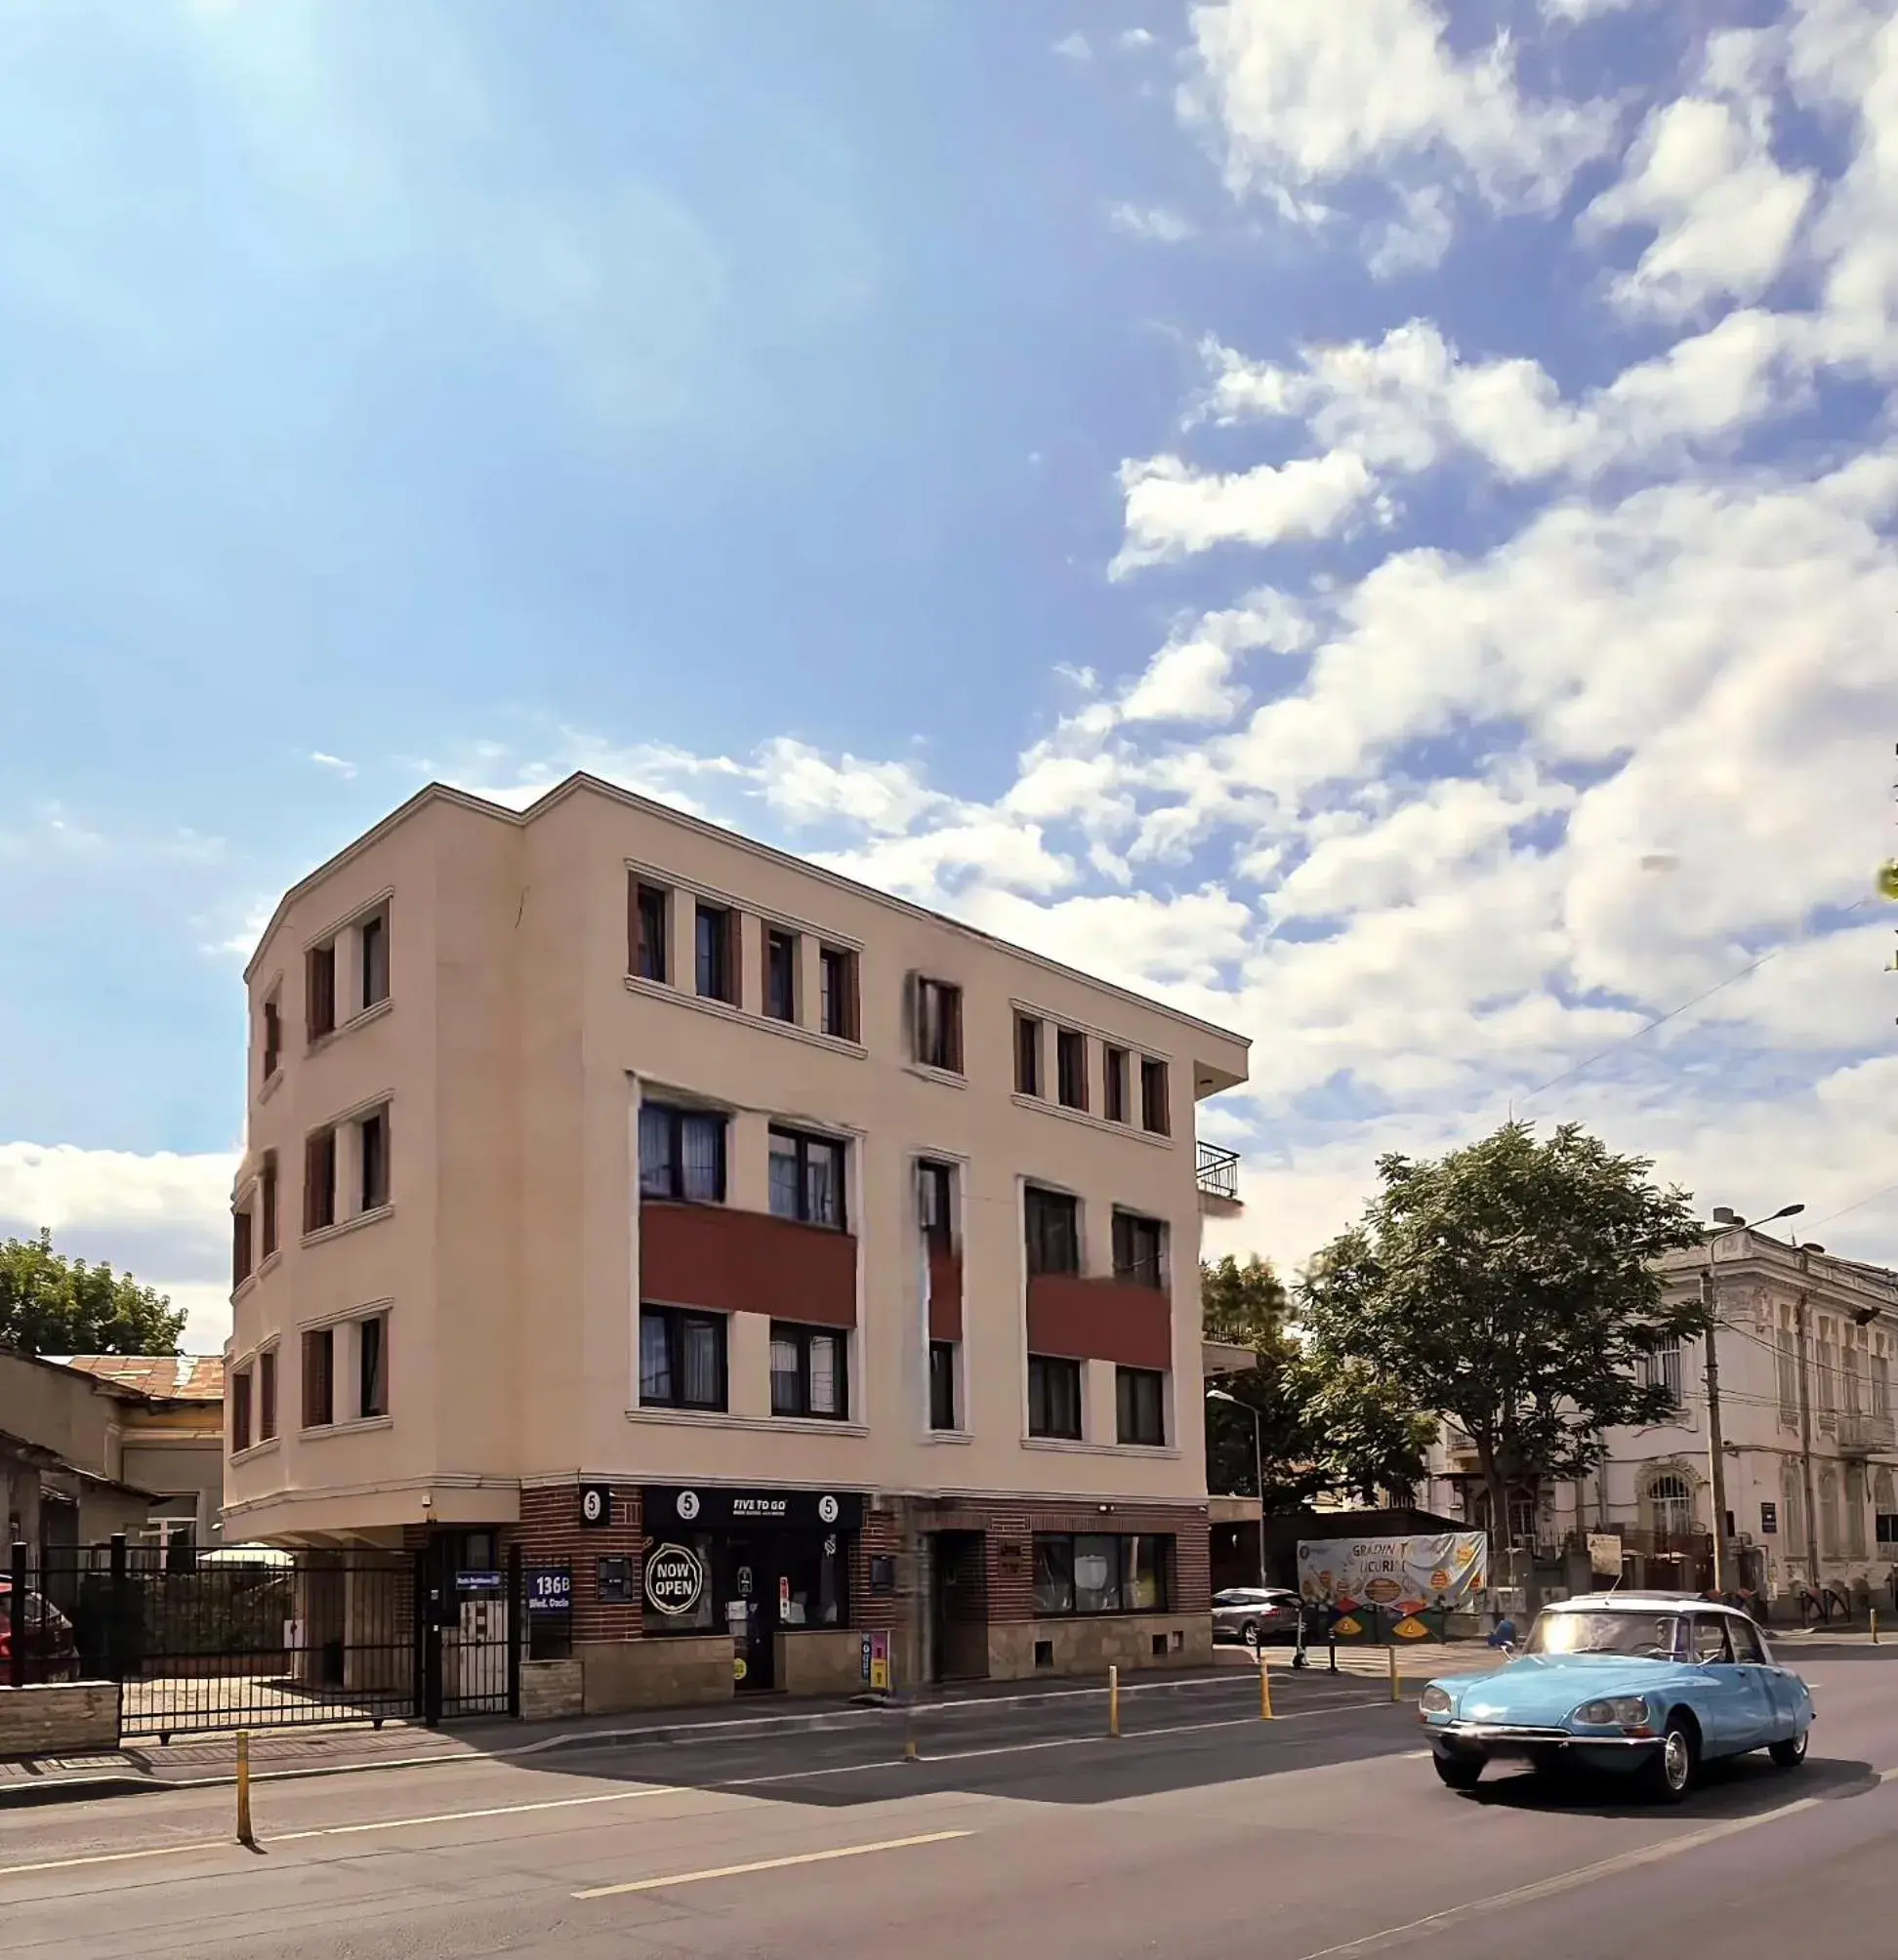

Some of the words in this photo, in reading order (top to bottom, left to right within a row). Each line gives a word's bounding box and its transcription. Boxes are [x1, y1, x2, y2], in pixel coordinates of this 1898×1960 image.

[733, 1499, 755, 1510] FIVE
[757, 1499, 769, 1510] TO
[770, 1500, 786, 1510] GO
[657, 1563, 689, 1577] NOW
[655, 1579, 692, 1595] OPEN
